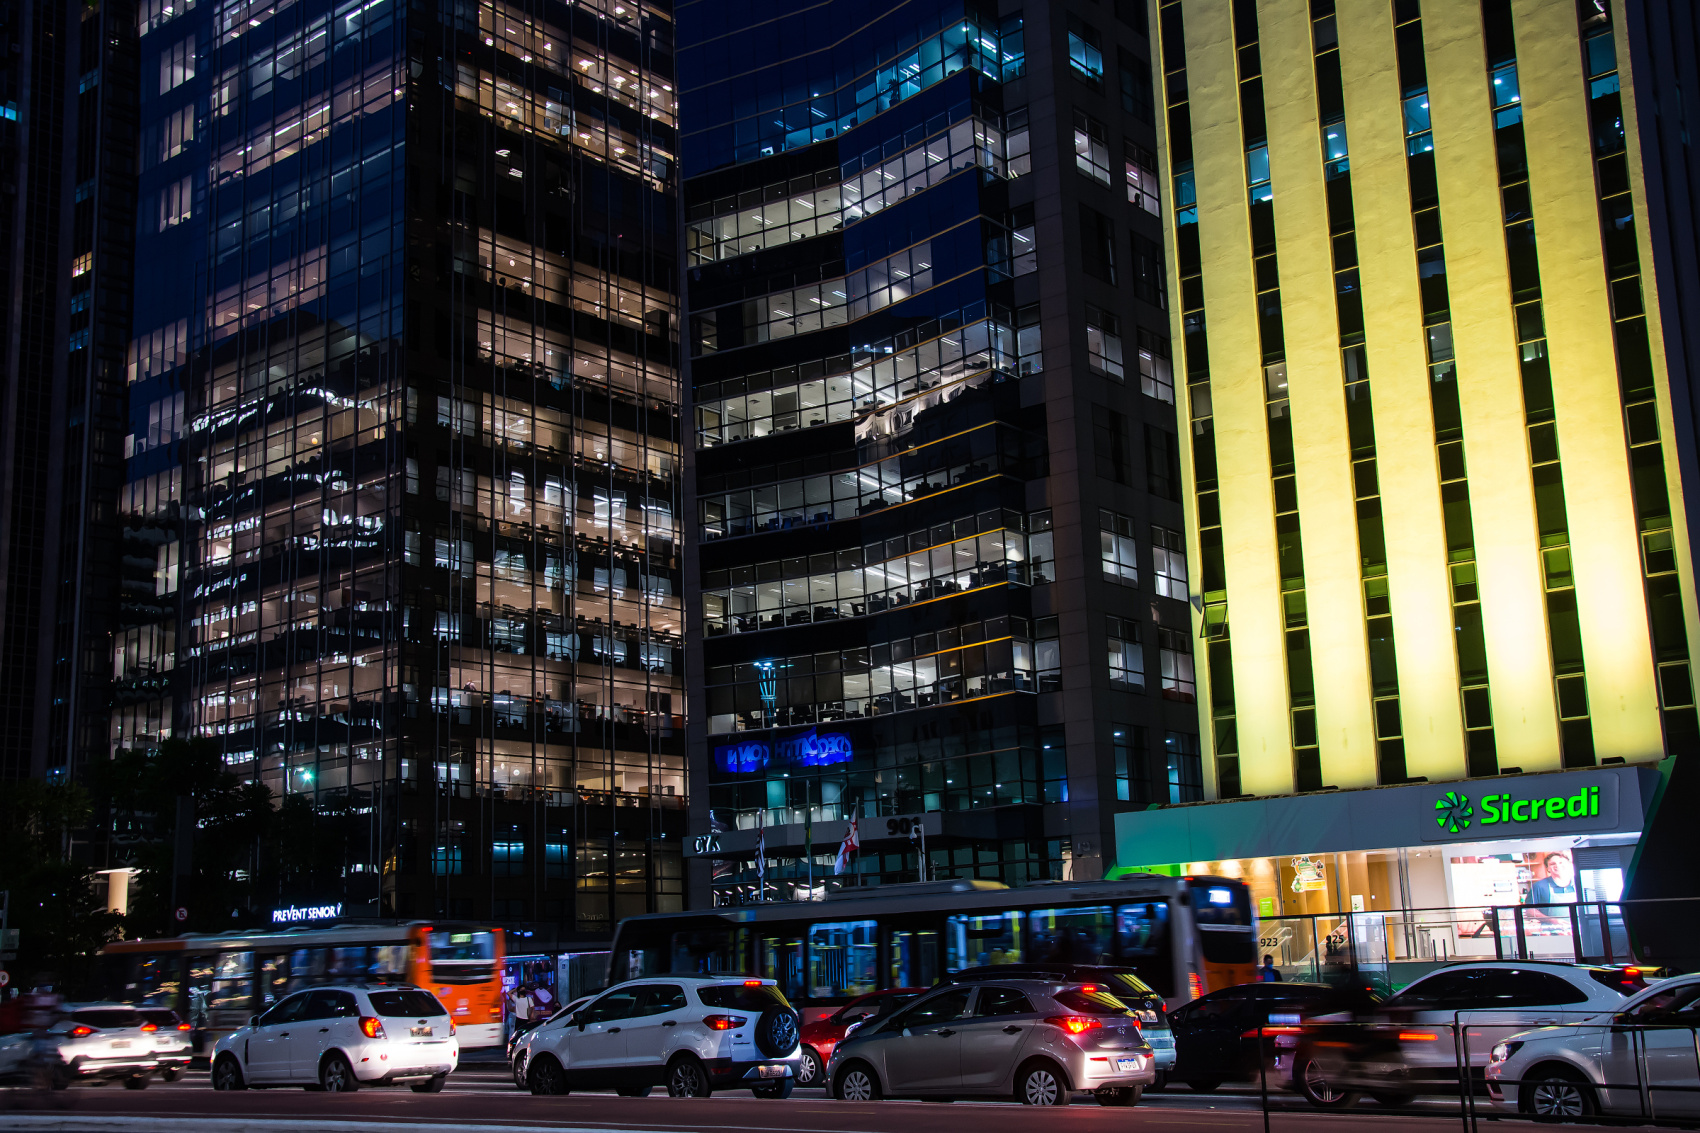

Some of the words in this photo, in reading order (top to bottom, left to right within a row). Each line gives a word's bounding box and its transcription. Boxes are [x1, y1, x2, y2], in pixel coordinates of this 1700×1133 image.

[1480, 786, 1600, 825] Sicredi
[273, 905, 307, 922] PREVENT
[308, 906, 336, 919] SENIOR
[1261, 938, 1278, 947] 923
[1326, 935, 1344, 944] 925
